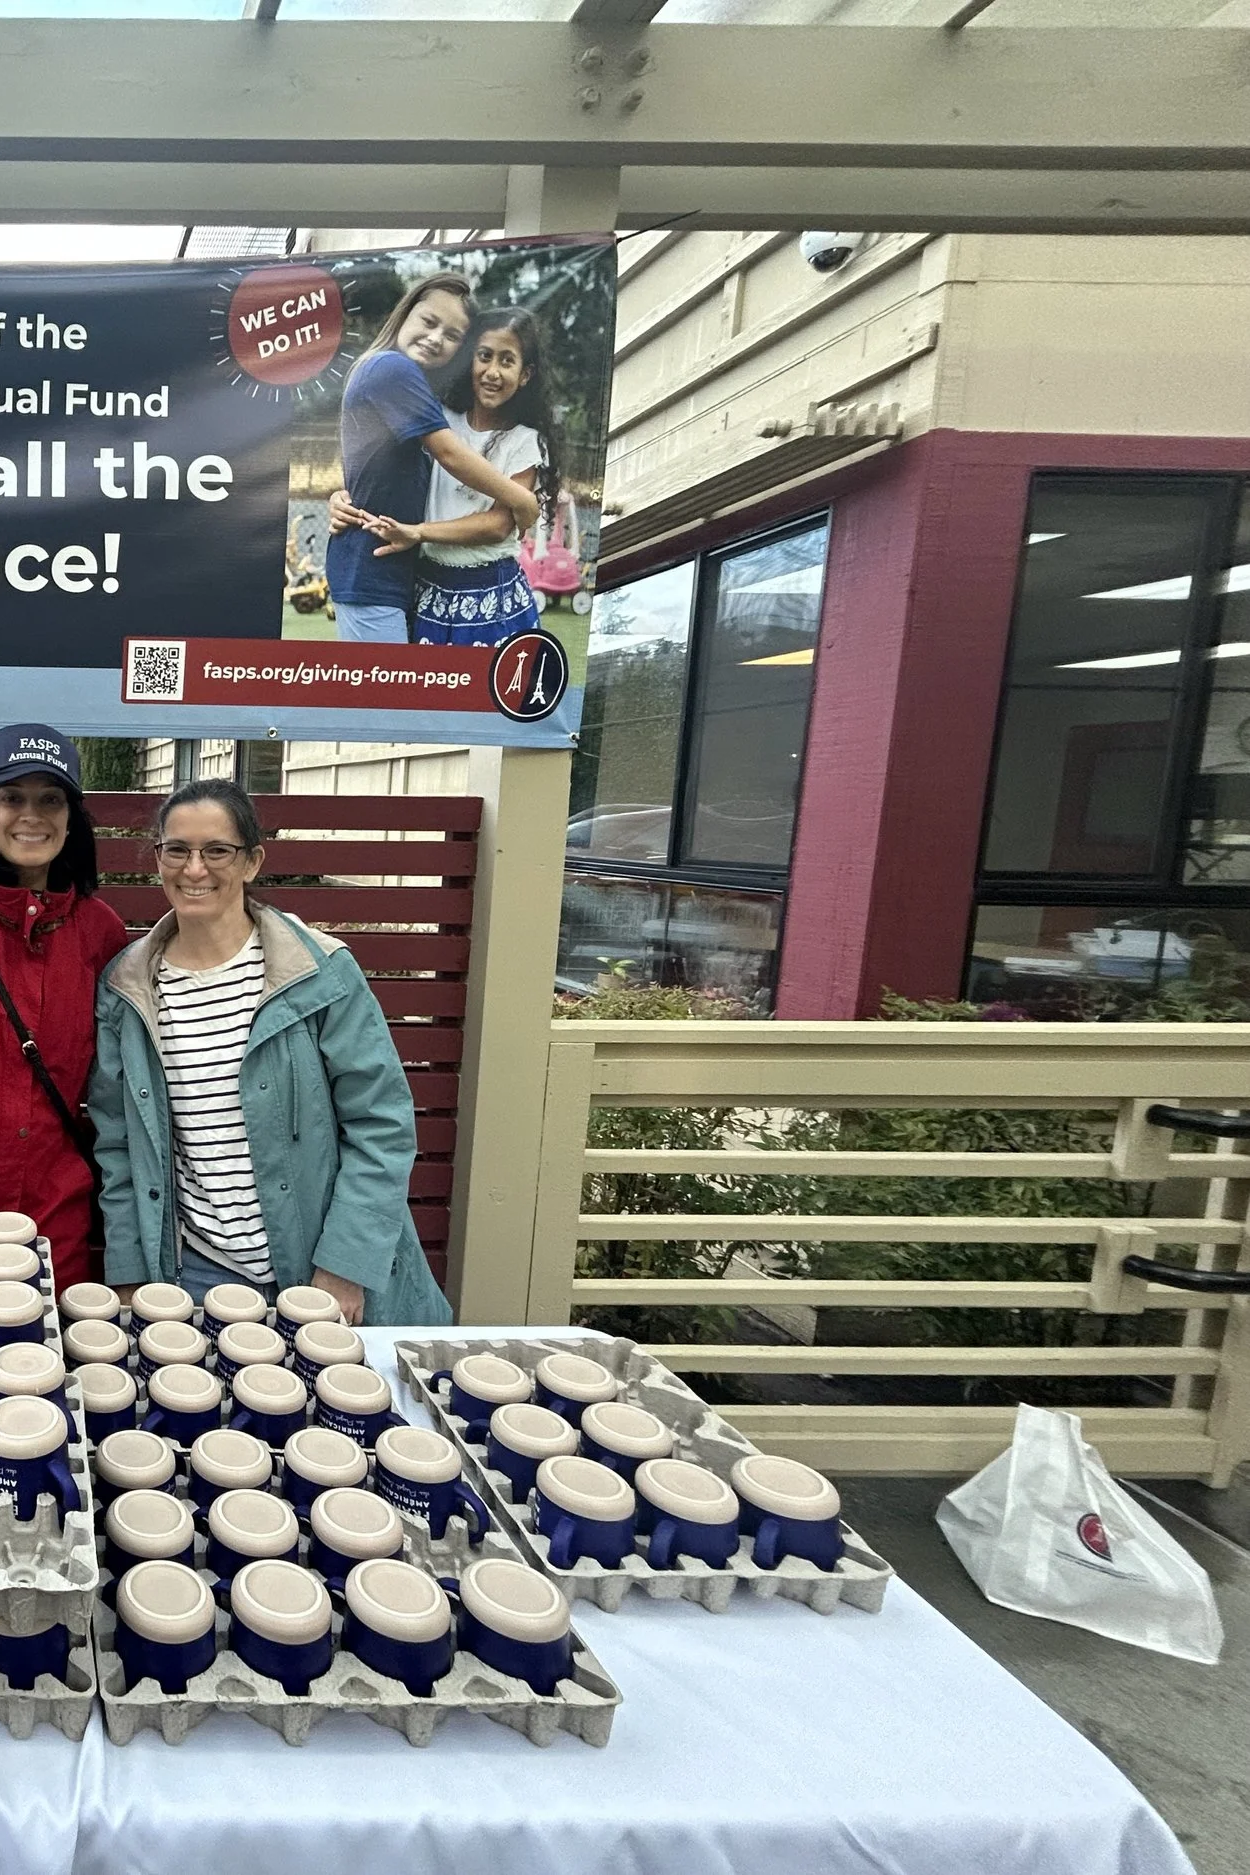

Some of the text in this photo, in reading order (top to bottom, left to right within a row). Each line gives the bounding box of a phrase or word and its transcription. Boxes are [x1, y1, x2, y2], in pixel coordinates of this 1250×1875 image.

[239, 288, 327, 333] WE CAN
[16, 313, 88, 351] the
[257, 322, 322, 359] DO IT!
[65, 383, 169, 418] Fund
[93, 441, 234, 502] the
[203, 661, 472, 689] fasps.org/giving-form-page
[9, 752, 67, 772] Annual Fund
[20, 738, 60, 755] FASPS
